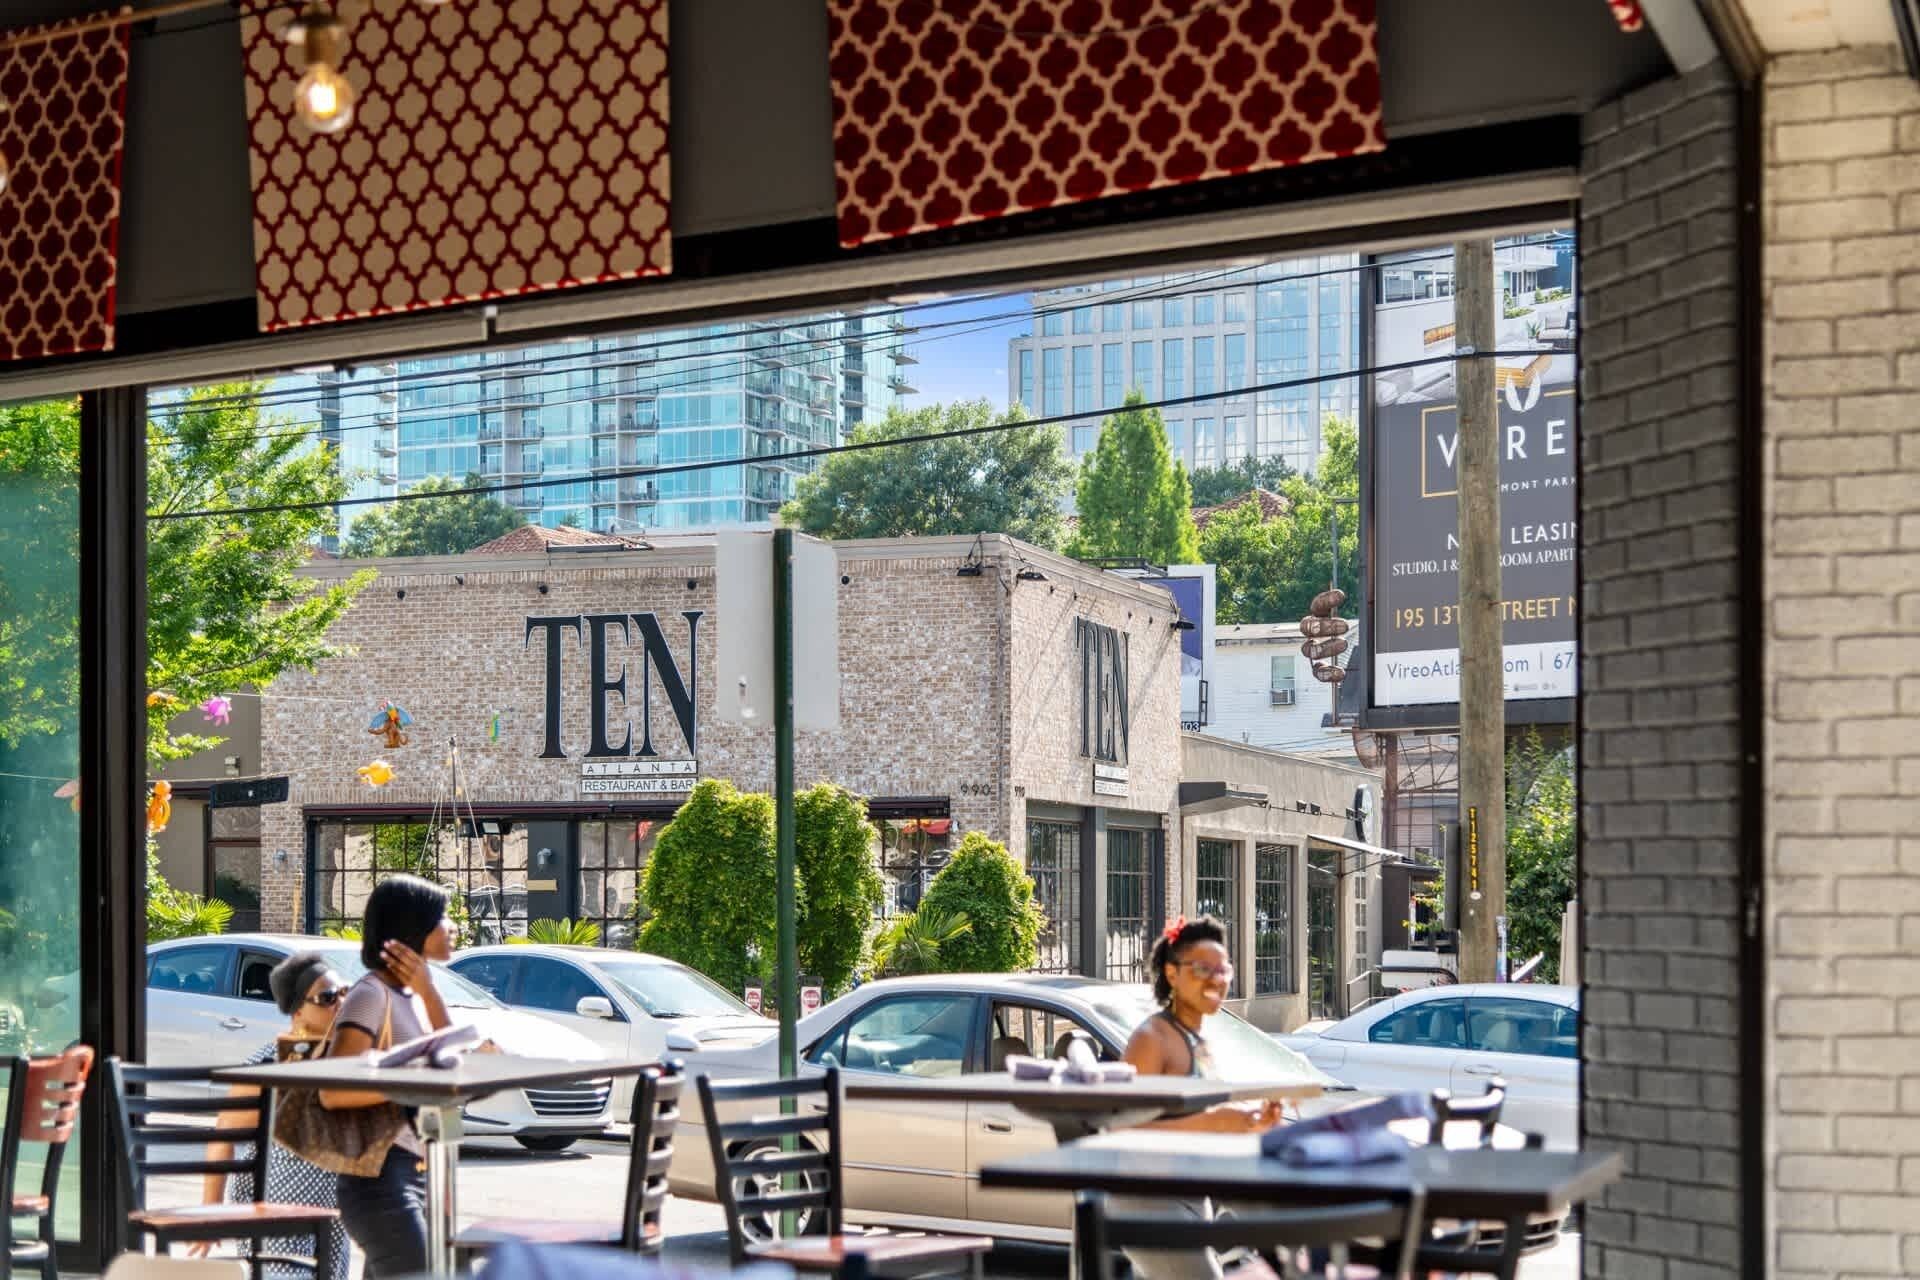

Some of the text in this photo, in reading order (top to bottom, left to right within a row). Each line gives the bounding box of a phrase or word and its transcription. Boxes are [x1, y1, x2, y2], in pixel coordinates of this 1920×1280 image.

[1436, 419, 1567, 468] VRE
[1394, 607, 1425, 629] 195
[1500, 597, 1561, 622] TREET
[525, 611, 704, 759] TEN
[1073, 616, 1129, 766] TEN
[586, 763, 692, 774] ATLANTA
[584, 779, 693, 791] RESTAURANT & BAR
[960, 783, 991, 796] 990
